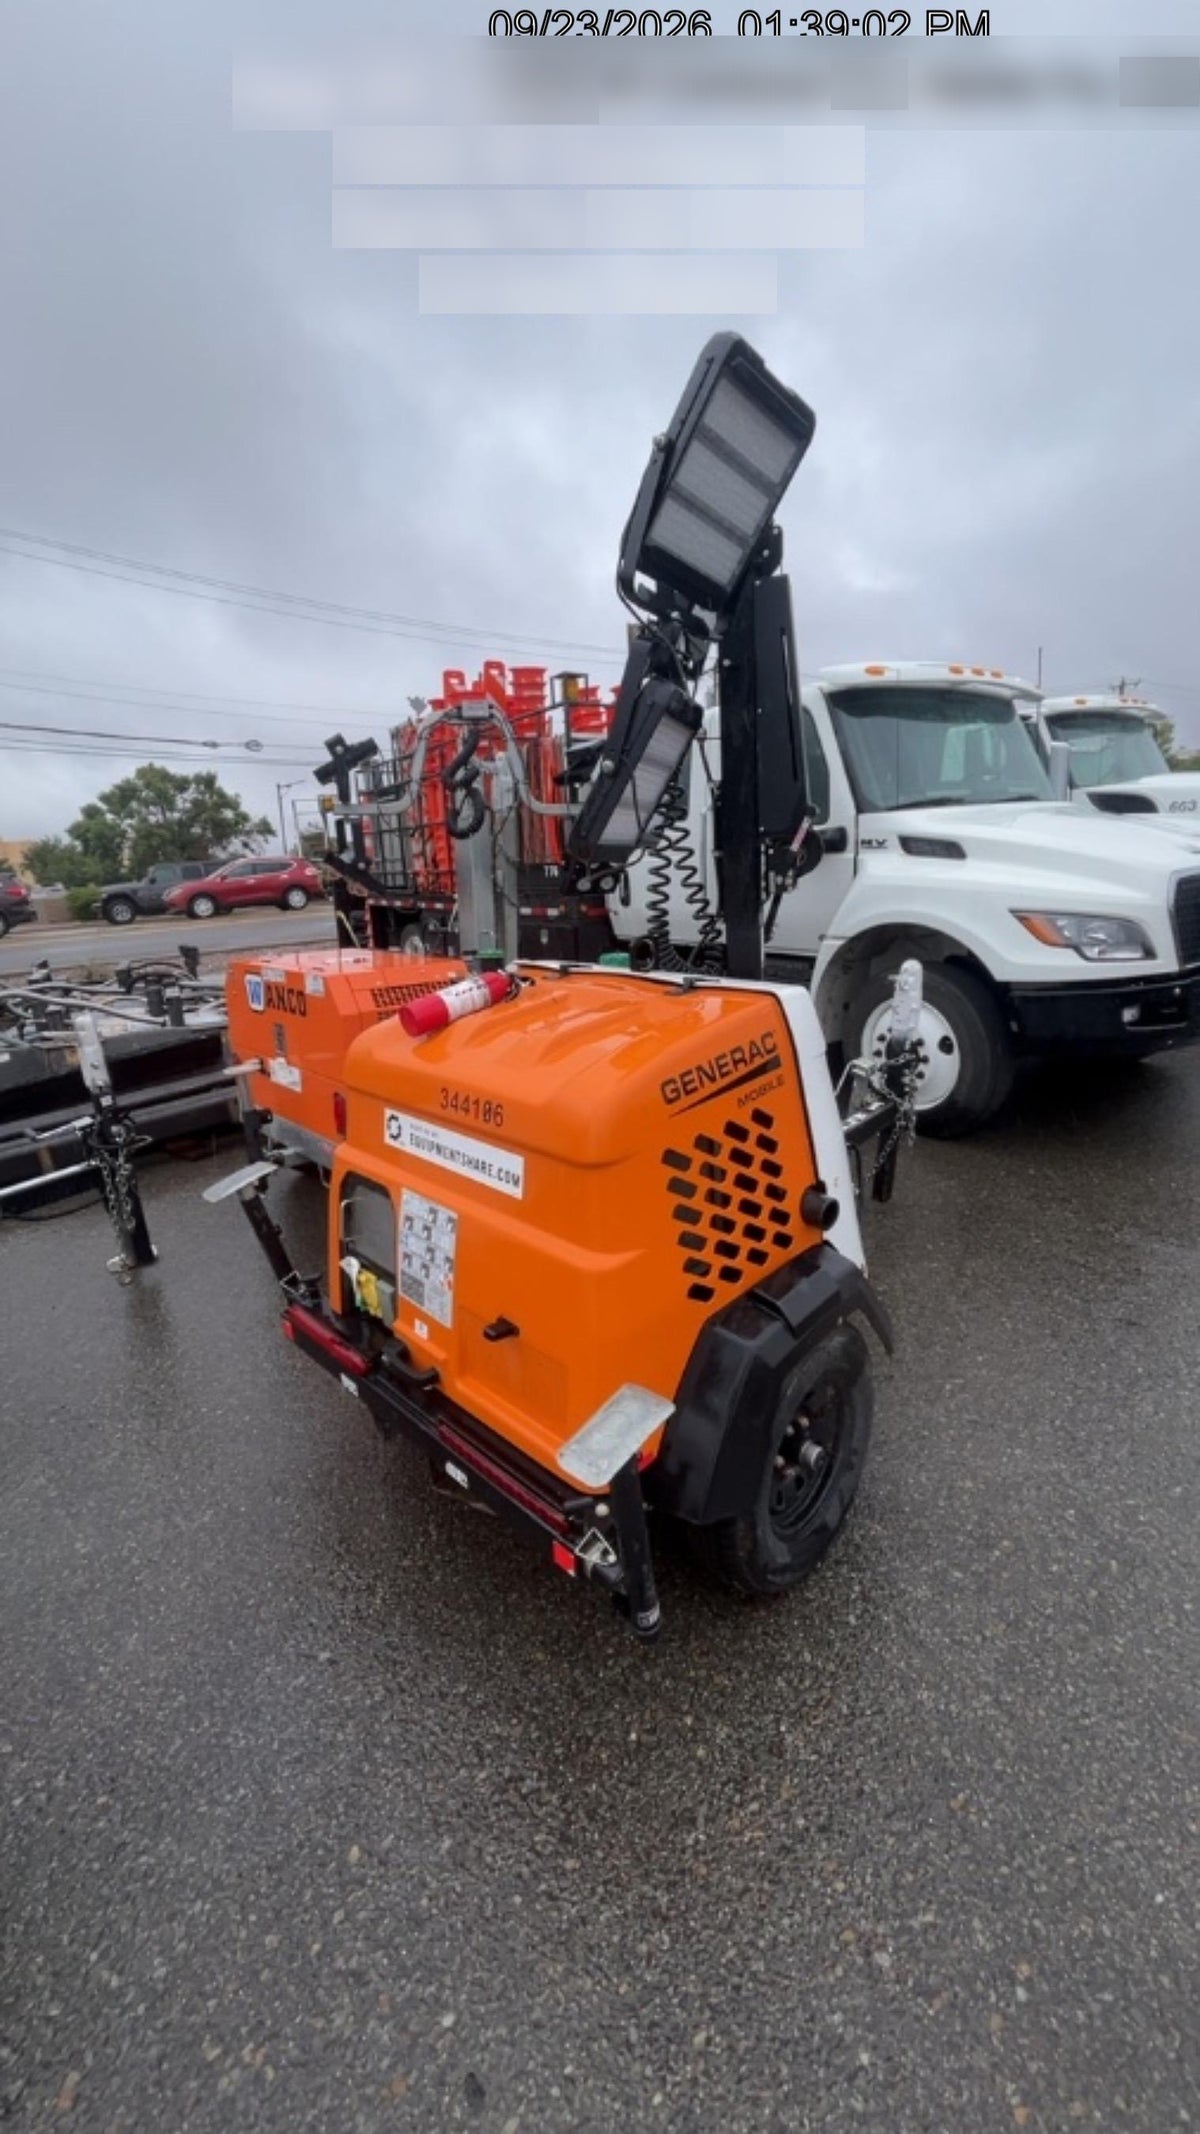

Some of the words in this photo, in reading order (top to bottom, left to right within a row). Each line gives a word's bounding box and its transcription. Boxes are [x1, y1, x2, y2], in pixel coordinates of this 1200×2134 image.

[660, 1031, 778, 1105] GENERAC
[737, 1073, 785, 1109] MOBILE
[409, 1132, 520, 1188] EQUIPMENTSHARE.COM
